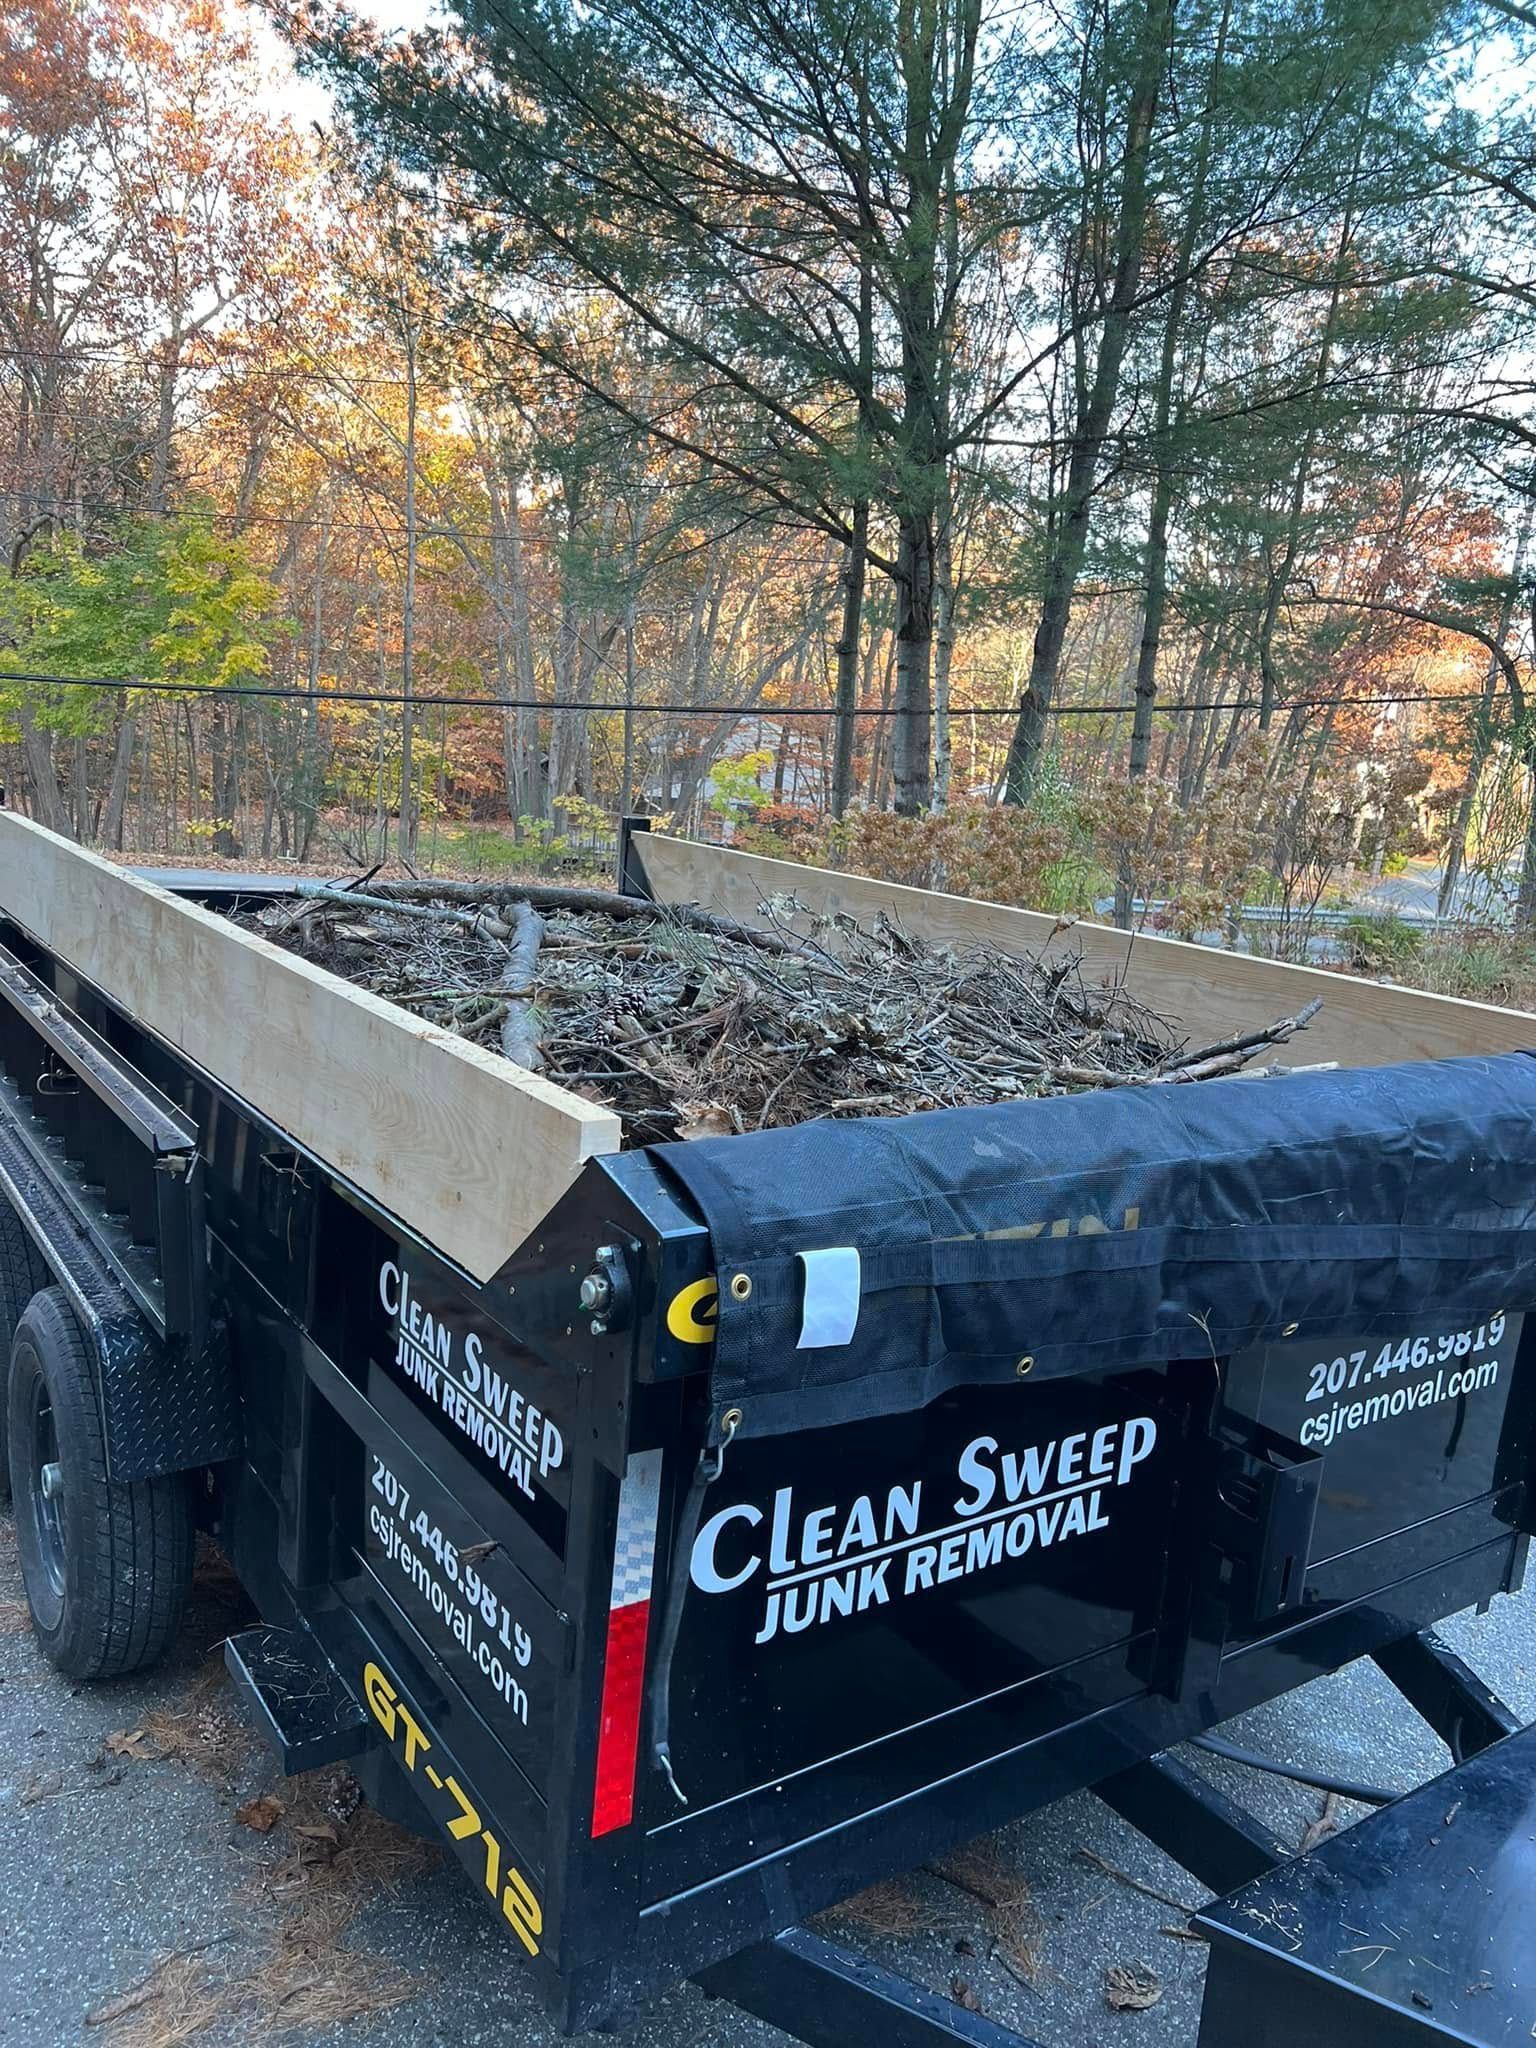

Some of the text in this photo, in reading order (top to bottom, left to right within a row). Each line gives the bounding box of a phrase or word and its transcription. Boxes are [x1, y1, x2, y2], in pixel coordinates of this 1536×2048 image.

[395, 1336, 536, 1500] JUNK REMOVAL
[1300, 1361, 1498, 1447] csjremoval.com
[1304, 1315, 1506, 1402] 207.446.9819
[370, 1504, 528, 1726] csjremoval.com
[371, 1456, 532, 1667] 207.446.9819
[755, 1490, 1110, 1644] JUNK REMOVAL
[363, 1662, 541, 1957] GT-712
